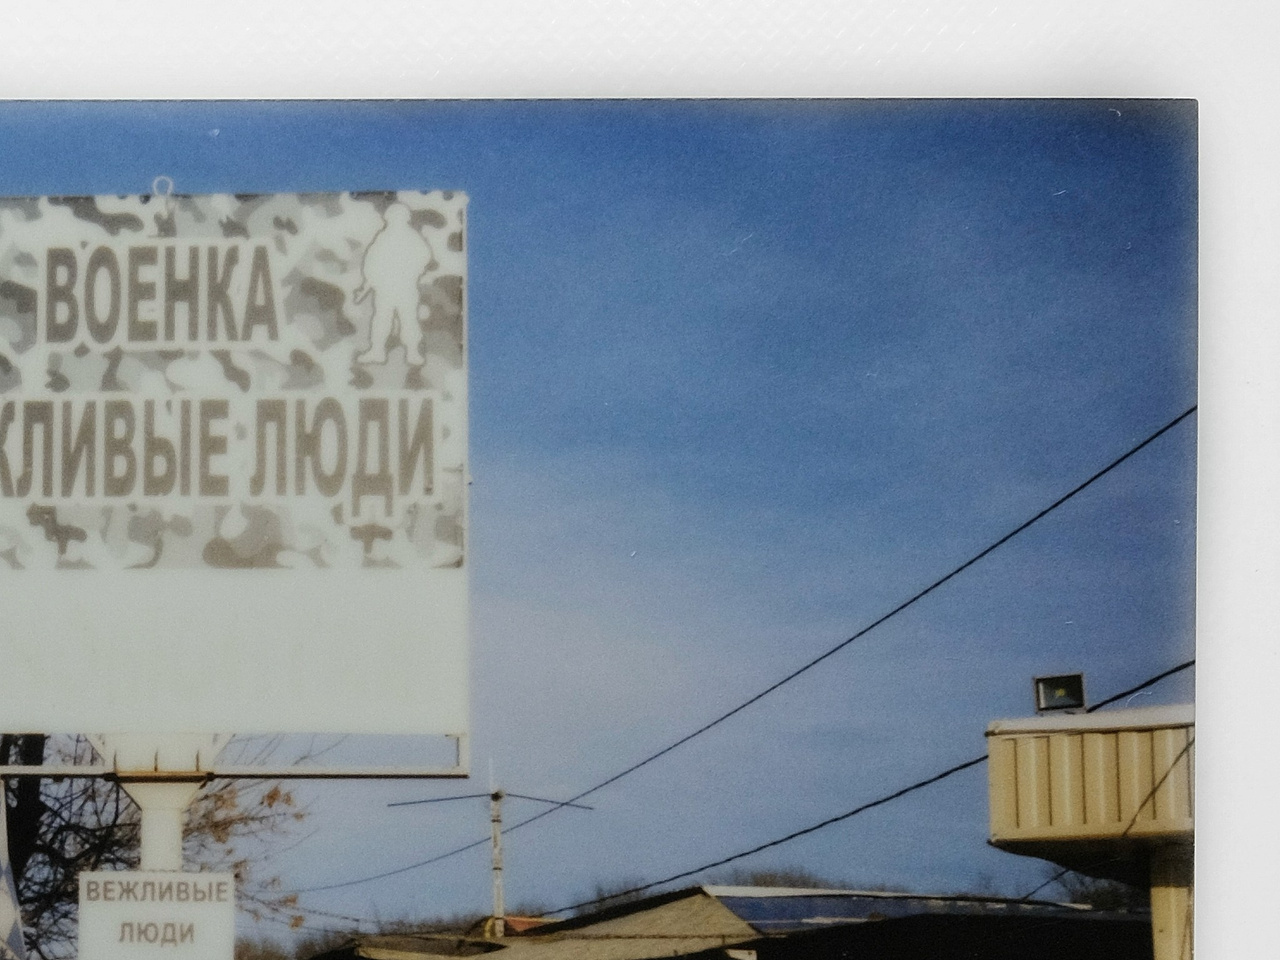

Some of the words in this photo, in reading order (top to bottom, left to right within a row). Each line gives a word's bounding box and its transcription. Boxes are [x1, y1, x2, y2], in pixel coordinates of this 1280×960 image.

[44, 244, 280, 345] ВОЕНКА
[249, 396, 436, 519] ЛЮДИ
[86, 880, 228, 902] ВЕЖЛИВЫЕ
[119, 921, 196, 947] ЛЮДИ
